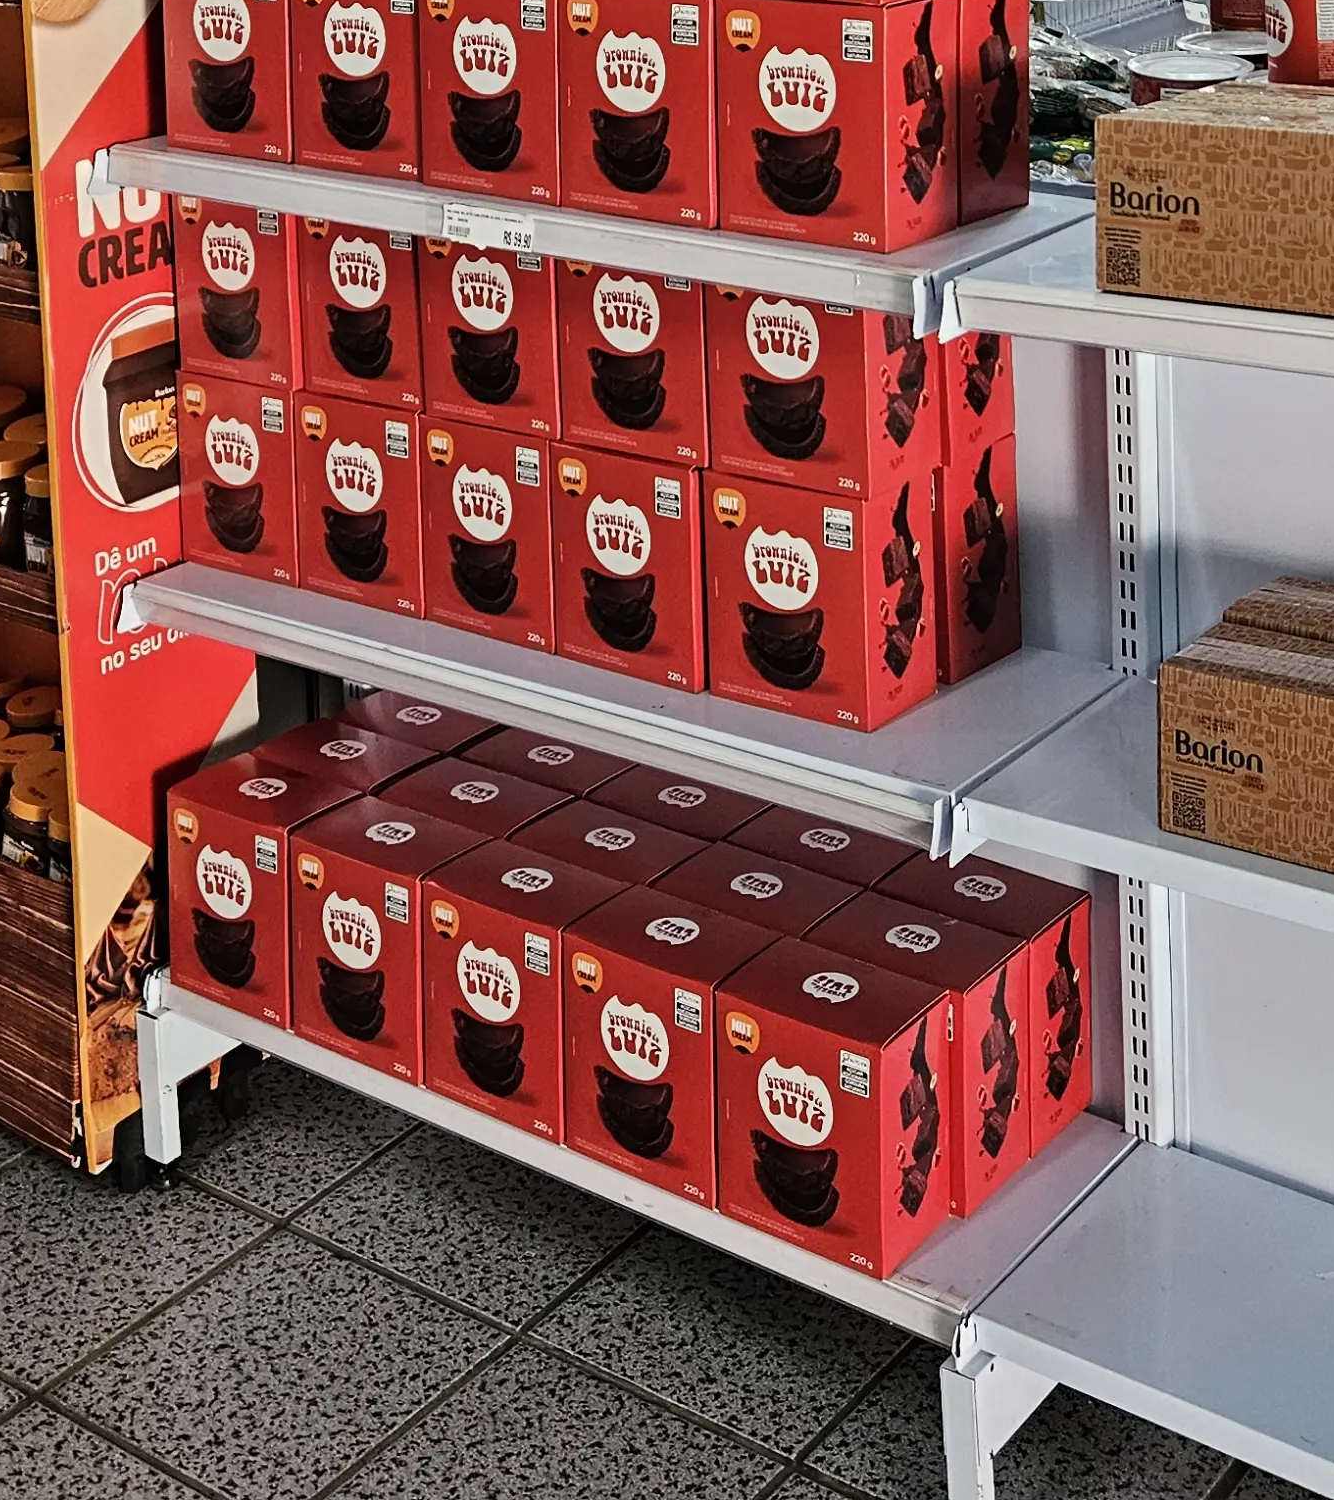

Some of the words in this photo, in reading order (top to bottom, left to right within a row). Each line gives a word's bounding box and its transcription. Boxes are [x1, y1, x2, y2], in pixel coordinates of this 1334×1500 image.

[199, 3, 236, 19] brownie
[329, 18, 370, 32] brownie
[199, 18, 245, 45] LUIZ
[330, 31, 380, 60] LUIZ
[458, 33, 500, 49] brownie
[459, 47, 511, 78] LUIZ
[602, 46, 648, 65] brownie
[603, 63, 659, 94] LUIZ
[765, 63, 817, 82] brownie
[766, 81, 829, 113] LUIZ
[1110, 182, 1200, 215] Barion
[78, 220, 172, 288] CREA
[503, 230, 512, 246] R$
[513, 231, 532, 249] 59,90
[599, 304, 654, 336] LUIZ
[752, 329, 812, 362] LUIZ
[128, 409, 157, 436] NUT
[130, 428, 159, 448] CREAM
[458, 494, 506, 527] LUIZ
[95, 546, 122, 576] Dê
[126, 537, 157, 563] um
[592, 526, 644, 560] LUIZ
[751, 559, 811, 594] LUIZ
[101, 650, 125, 675] no
[130, 632, 162, 661] seu
[1176, 729, 1264, 773] Barion
[463, 971, 514, 1010] LUIZ
[607, 1027, 663, 1068] LUIZ
[764, 1089, 827, 1133] LUIZ
